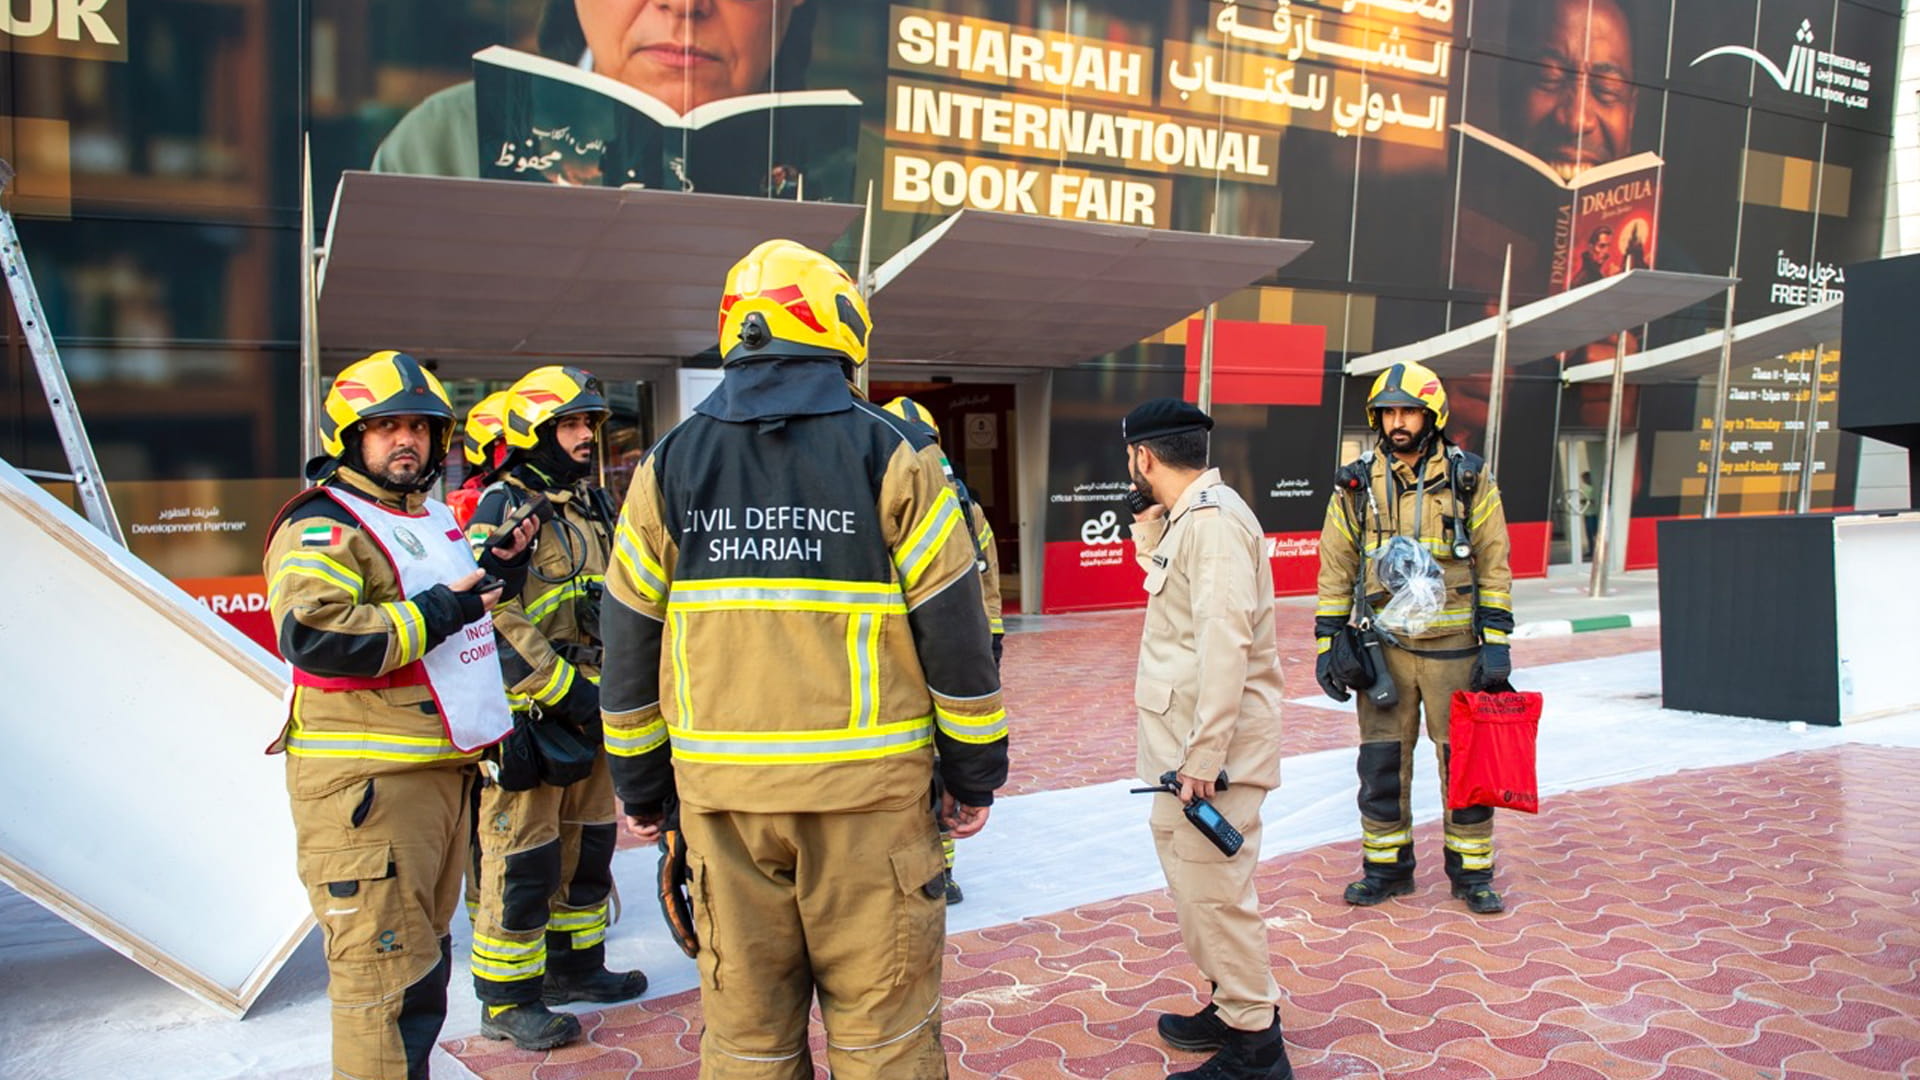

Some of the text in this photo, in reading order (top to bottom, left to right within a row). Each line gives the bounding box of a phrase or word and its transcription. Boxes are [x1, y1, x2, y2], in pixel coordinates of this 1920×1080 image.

[897, 15, 1142, 96] SHARJAH
[1216, 0, 1451, 77] الشارقة
[895, 85, 1270, 176] INTERNATIONAL
[1168, 55, 1447, 138] الدولي للكتاب
[892, 155, 1157, 226] BOOK FAIR
[1581, 179, 1653, 217] DRACULA
[1551, 203, 1572, 286] DRACULA
[1769, 283, 1845, 307] FREE ENTR
[131, 521, 247, 535] Development Partner
[708, 537, 822, 562] SHARJAH
[745, 506, 856, 534] DEFENCE
